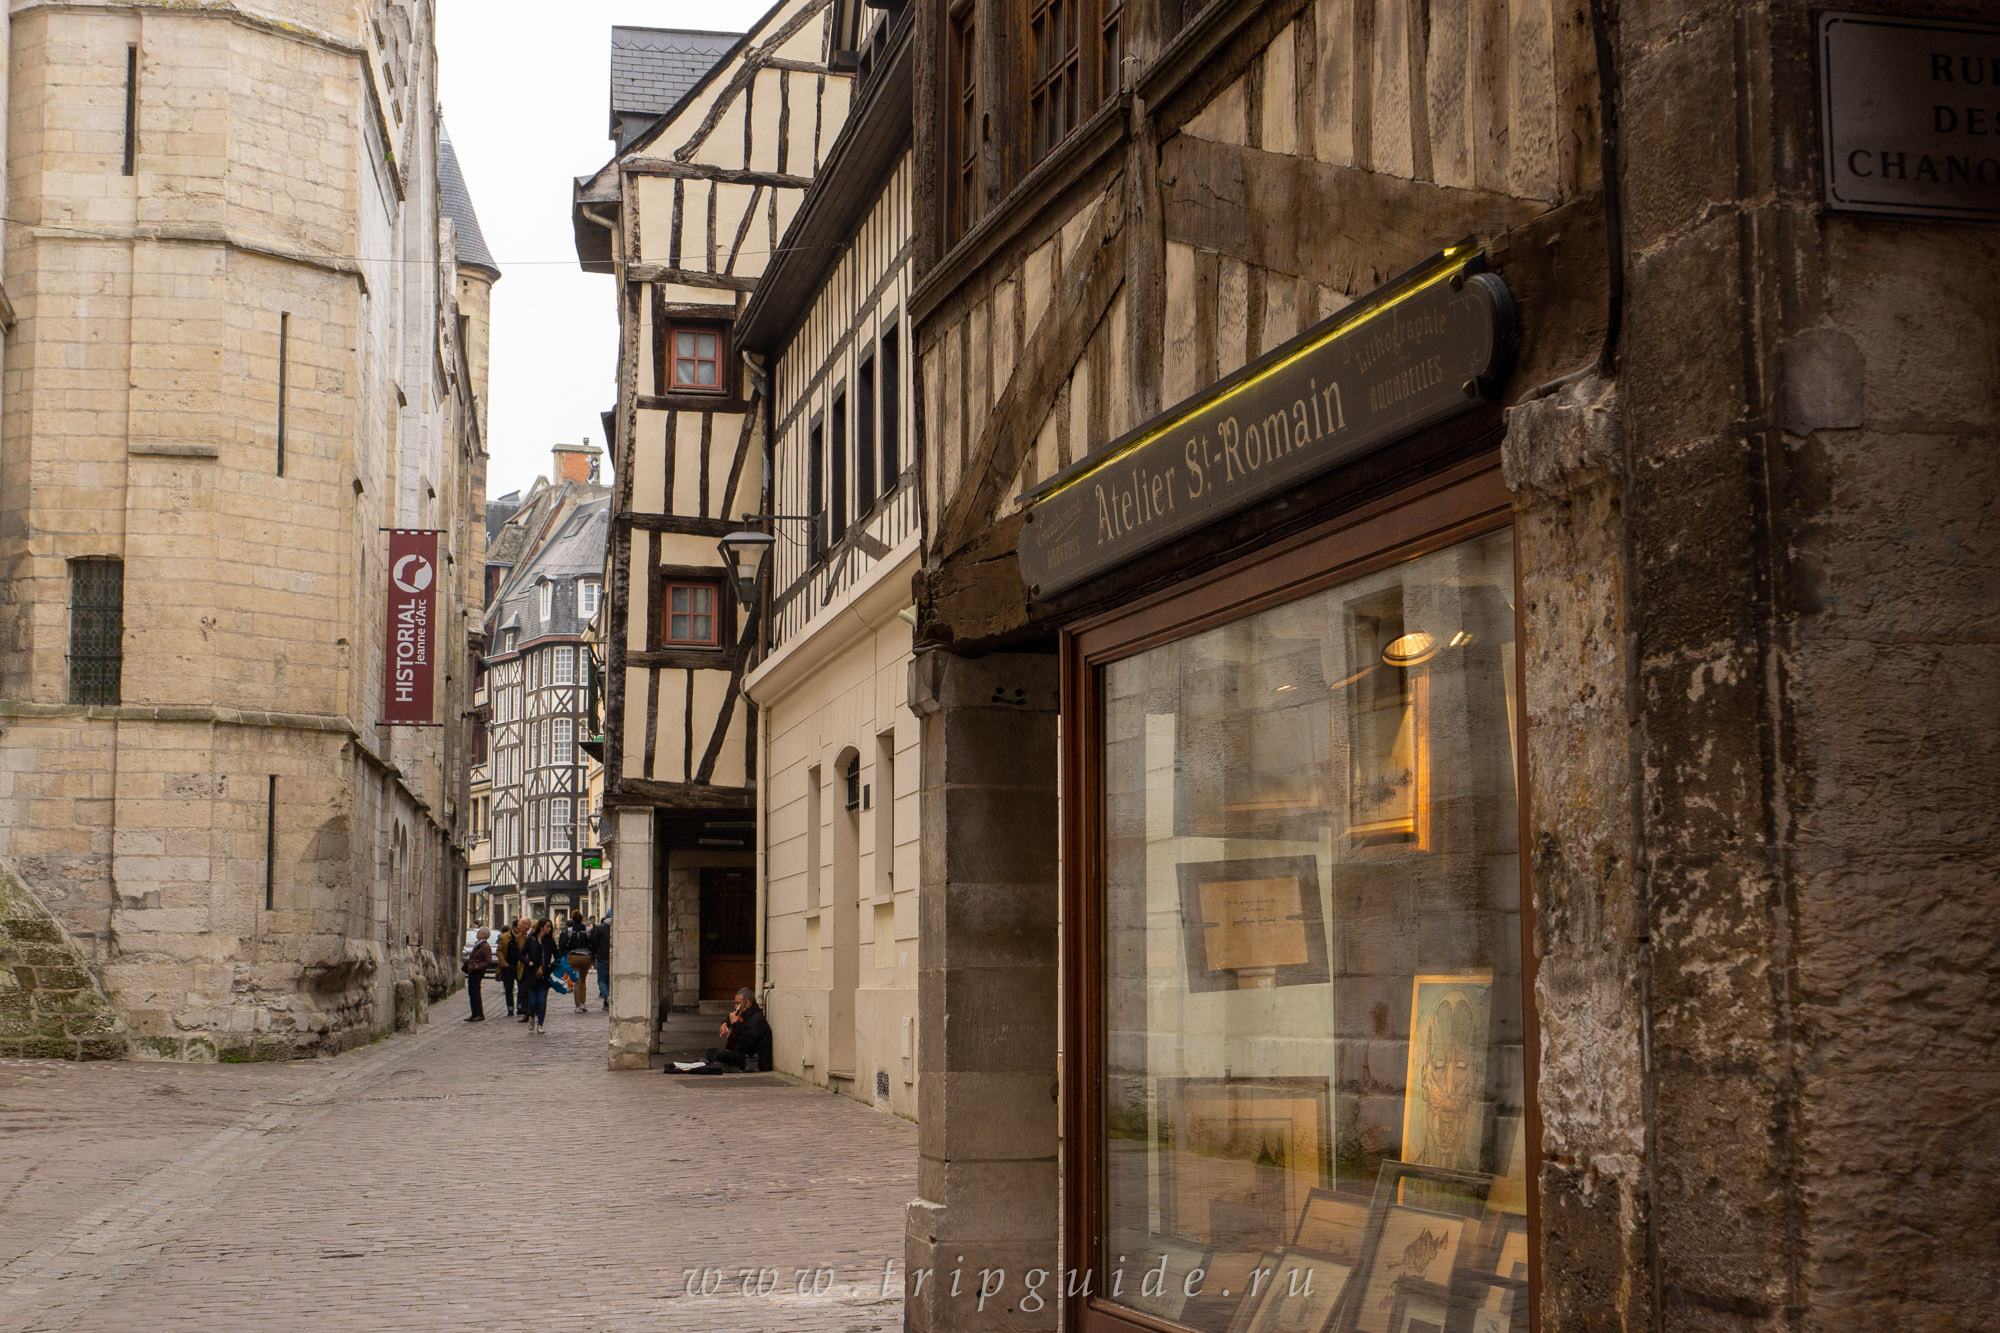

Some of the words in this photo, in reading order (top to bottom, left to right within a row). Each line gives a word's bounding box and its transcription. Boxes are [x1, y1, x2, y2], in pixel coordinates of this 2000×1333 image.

[1933, 105, 2000, 136] DE
[1355, 307, 1447, 375] Lithographie
[1370, 354, 1443, 414] AQUARELLES
[1095, 466, 1175, 546] Atelier
[415, 598, 427, 626] d'Arc
[395, 598, 416, 702] HISTORIAL
[414, 627, 428, 665] Jeanne
